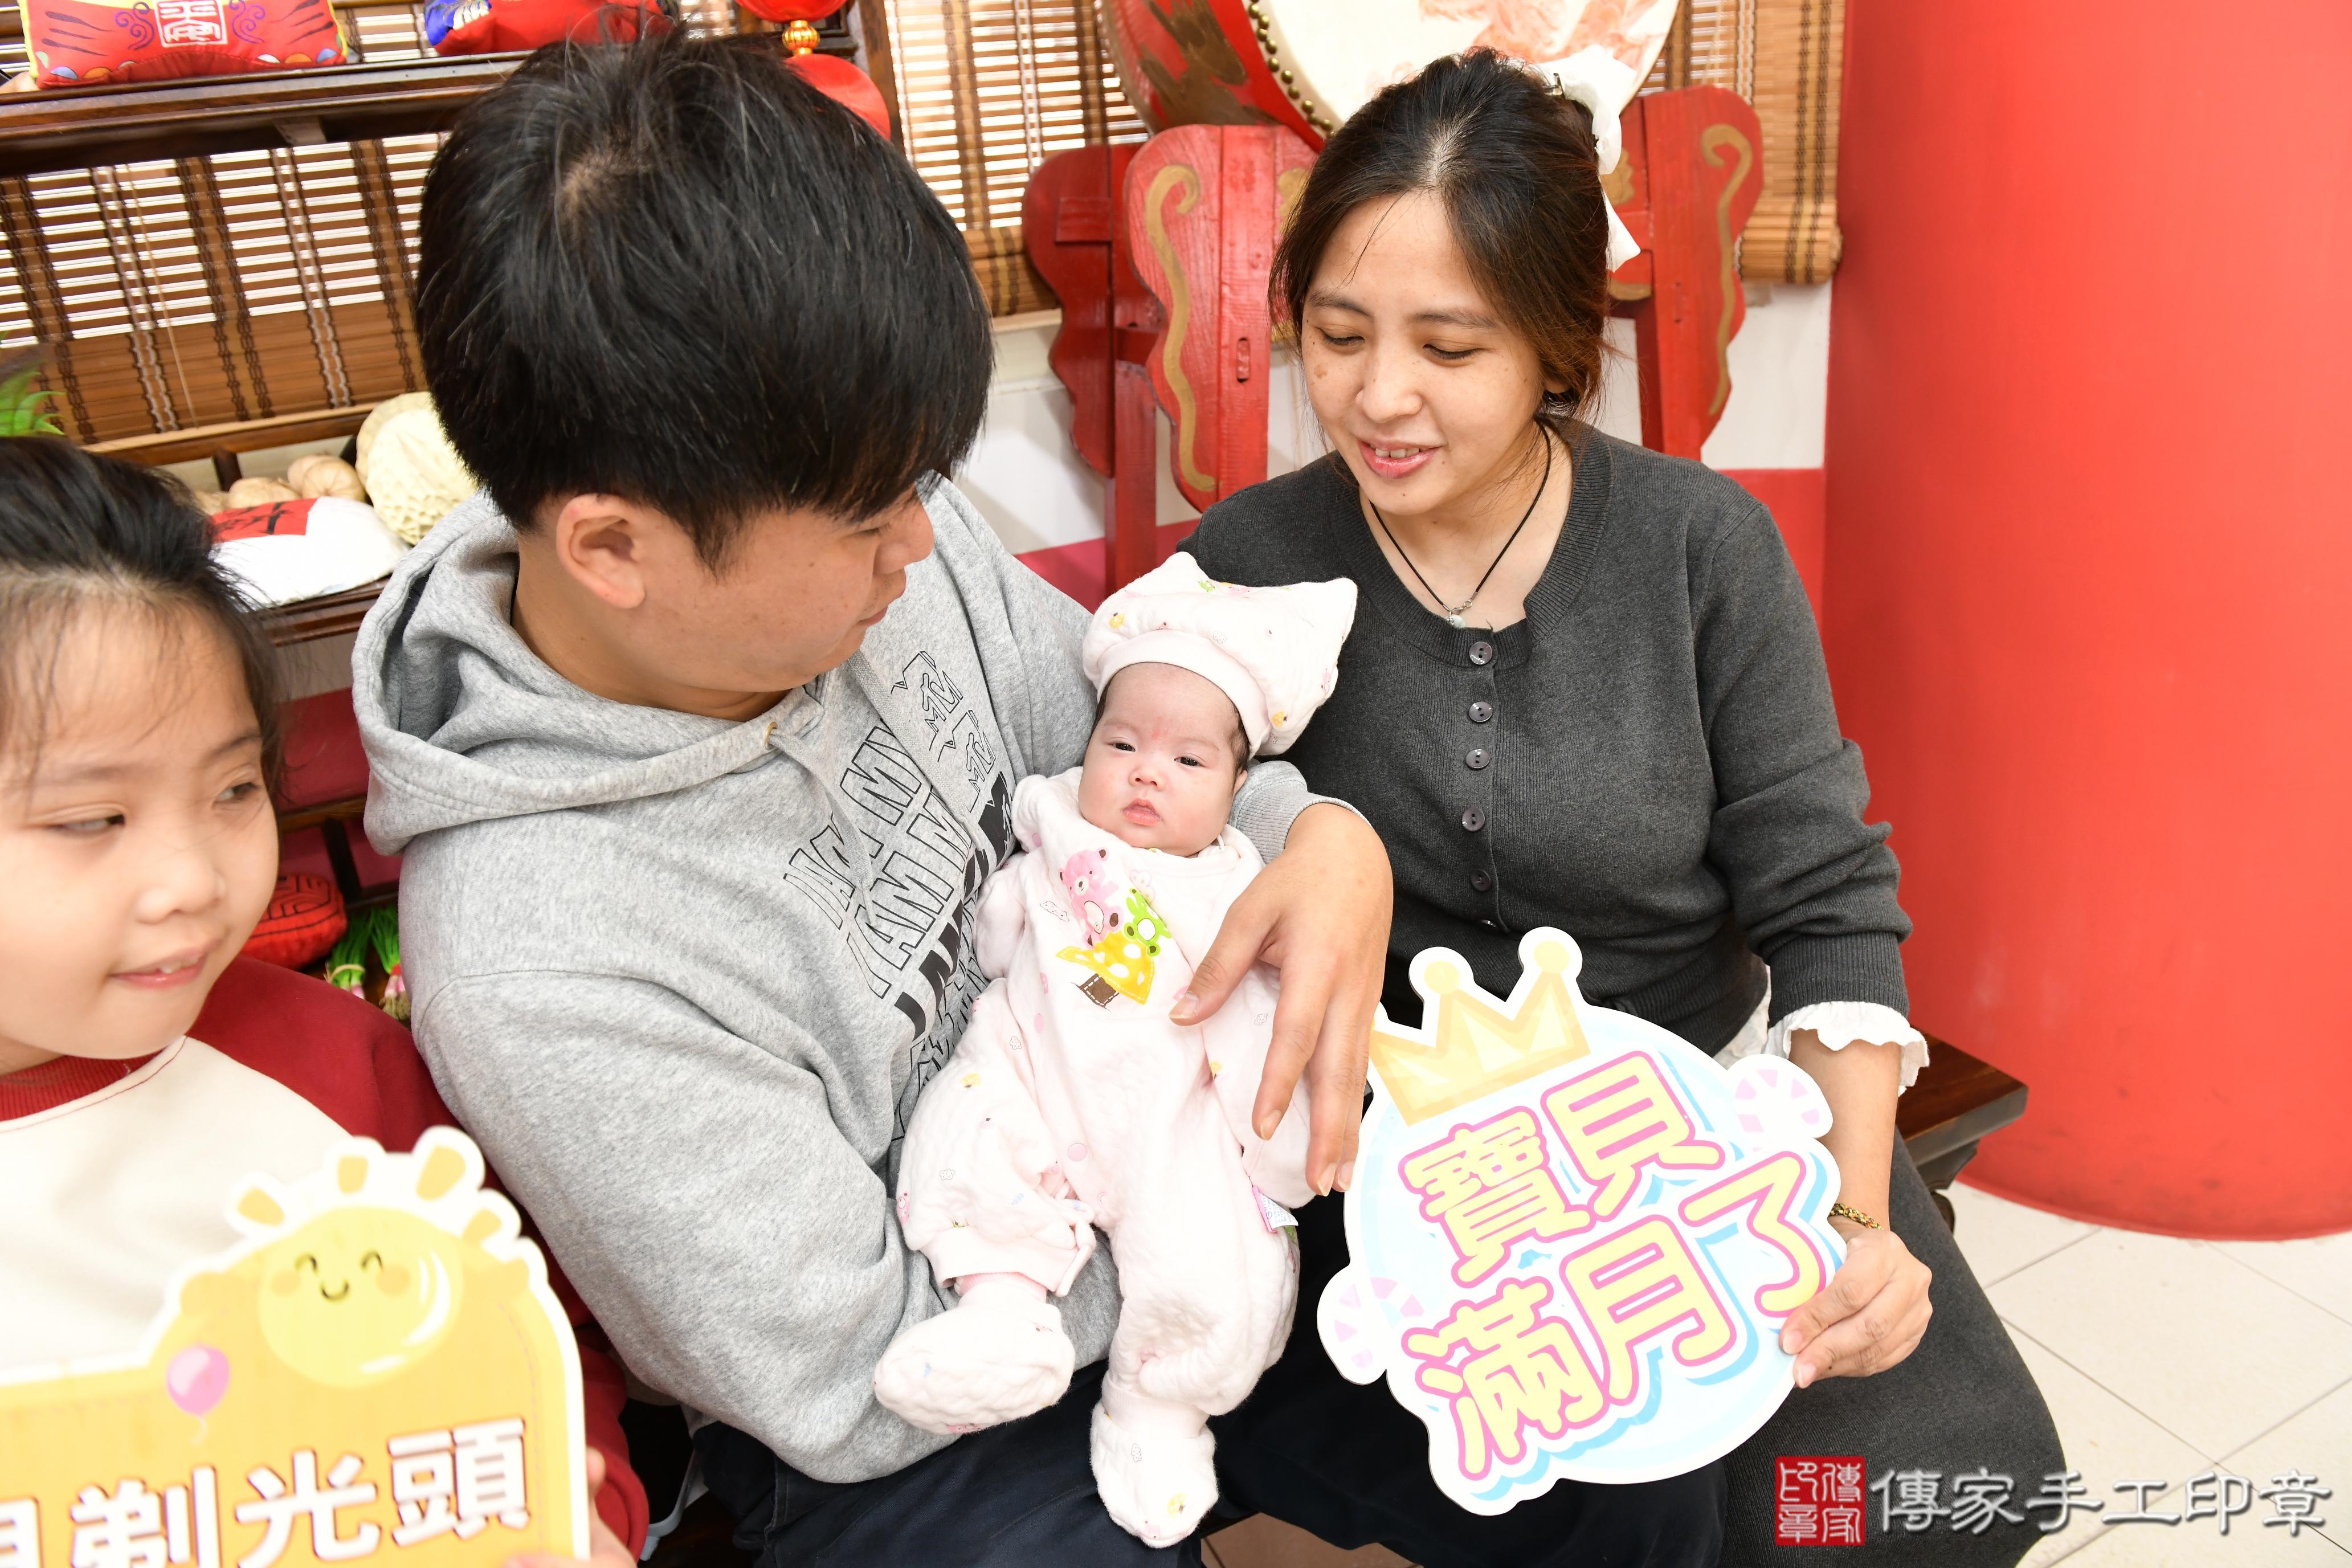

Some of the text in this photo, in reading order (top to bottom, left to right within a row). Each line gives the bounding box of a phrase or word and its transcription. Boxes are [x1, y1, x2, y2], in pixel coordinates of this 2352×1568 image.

[855, 851, 954, 970] AM
[906, 785, 972, 873] M
[1398, 1050, 1726, 1289] 寶貝
[1401, 1150, 1826, 1481] 滿月了
